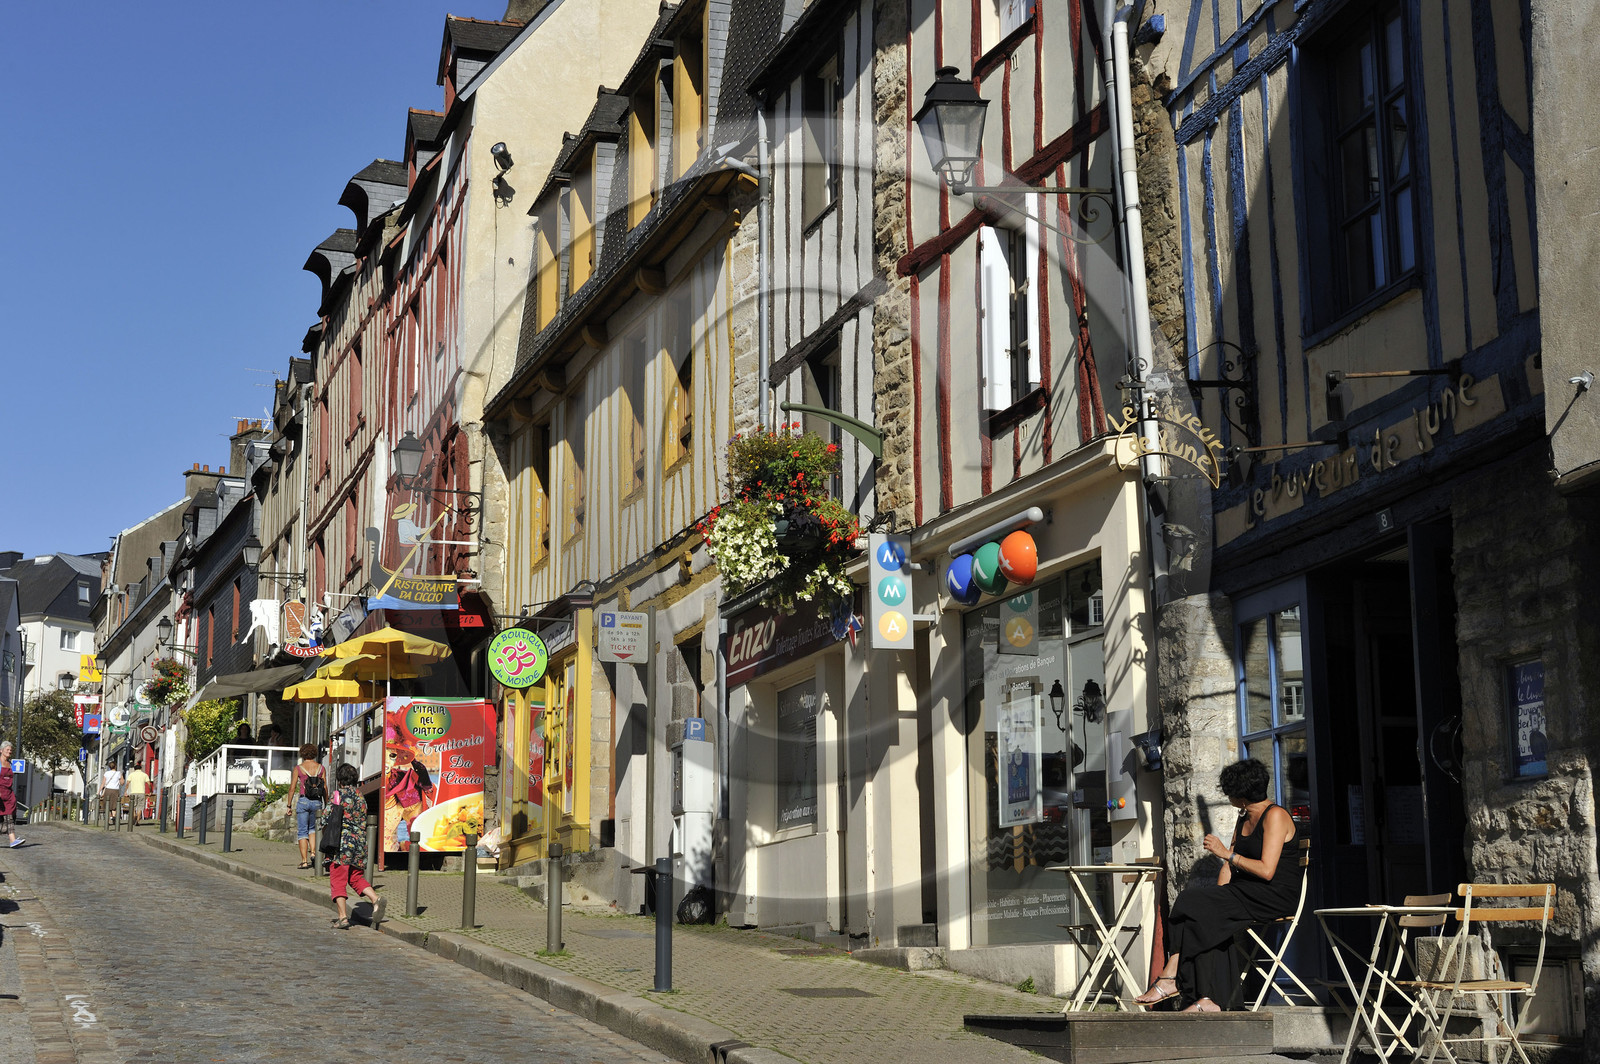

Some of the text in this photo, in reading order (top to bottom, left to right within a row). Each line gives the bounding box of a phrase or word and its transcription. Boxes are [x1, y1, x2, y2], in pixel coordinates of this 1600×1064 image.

[1371, 427, 1400, 472] de
[1412, 373, 1477, 451] lune
[1129, 429, 1212, 472] de lune
[1381, 513, 1388, 527] 8
[394, 579, 455, 593] RISTORANTE
[399, 590, 444, 603] DA CICCIO
[500, 630, 546, 657] BOUTIQUE
[286, 645, 324, 657] L'OASIS
[1036, 655, 1056, 668] Banque
[494, 668, 541, 686] du MONDE
[1012, 681, 1030, 692] Banque
[412, 705, 446, 716] L'ITALIA
[412, 726, 445, 736] PIATTO
[416, 734, 485, 756] Trattoria
[449, 754, 474, 769] Da
[441, 771, 484, 785] Ciccio
[1042, 893, 1067, 903] Placements
[1022, 907, 1039, 919] Risques
[1039, 904, 1070, 917] Professionnels
